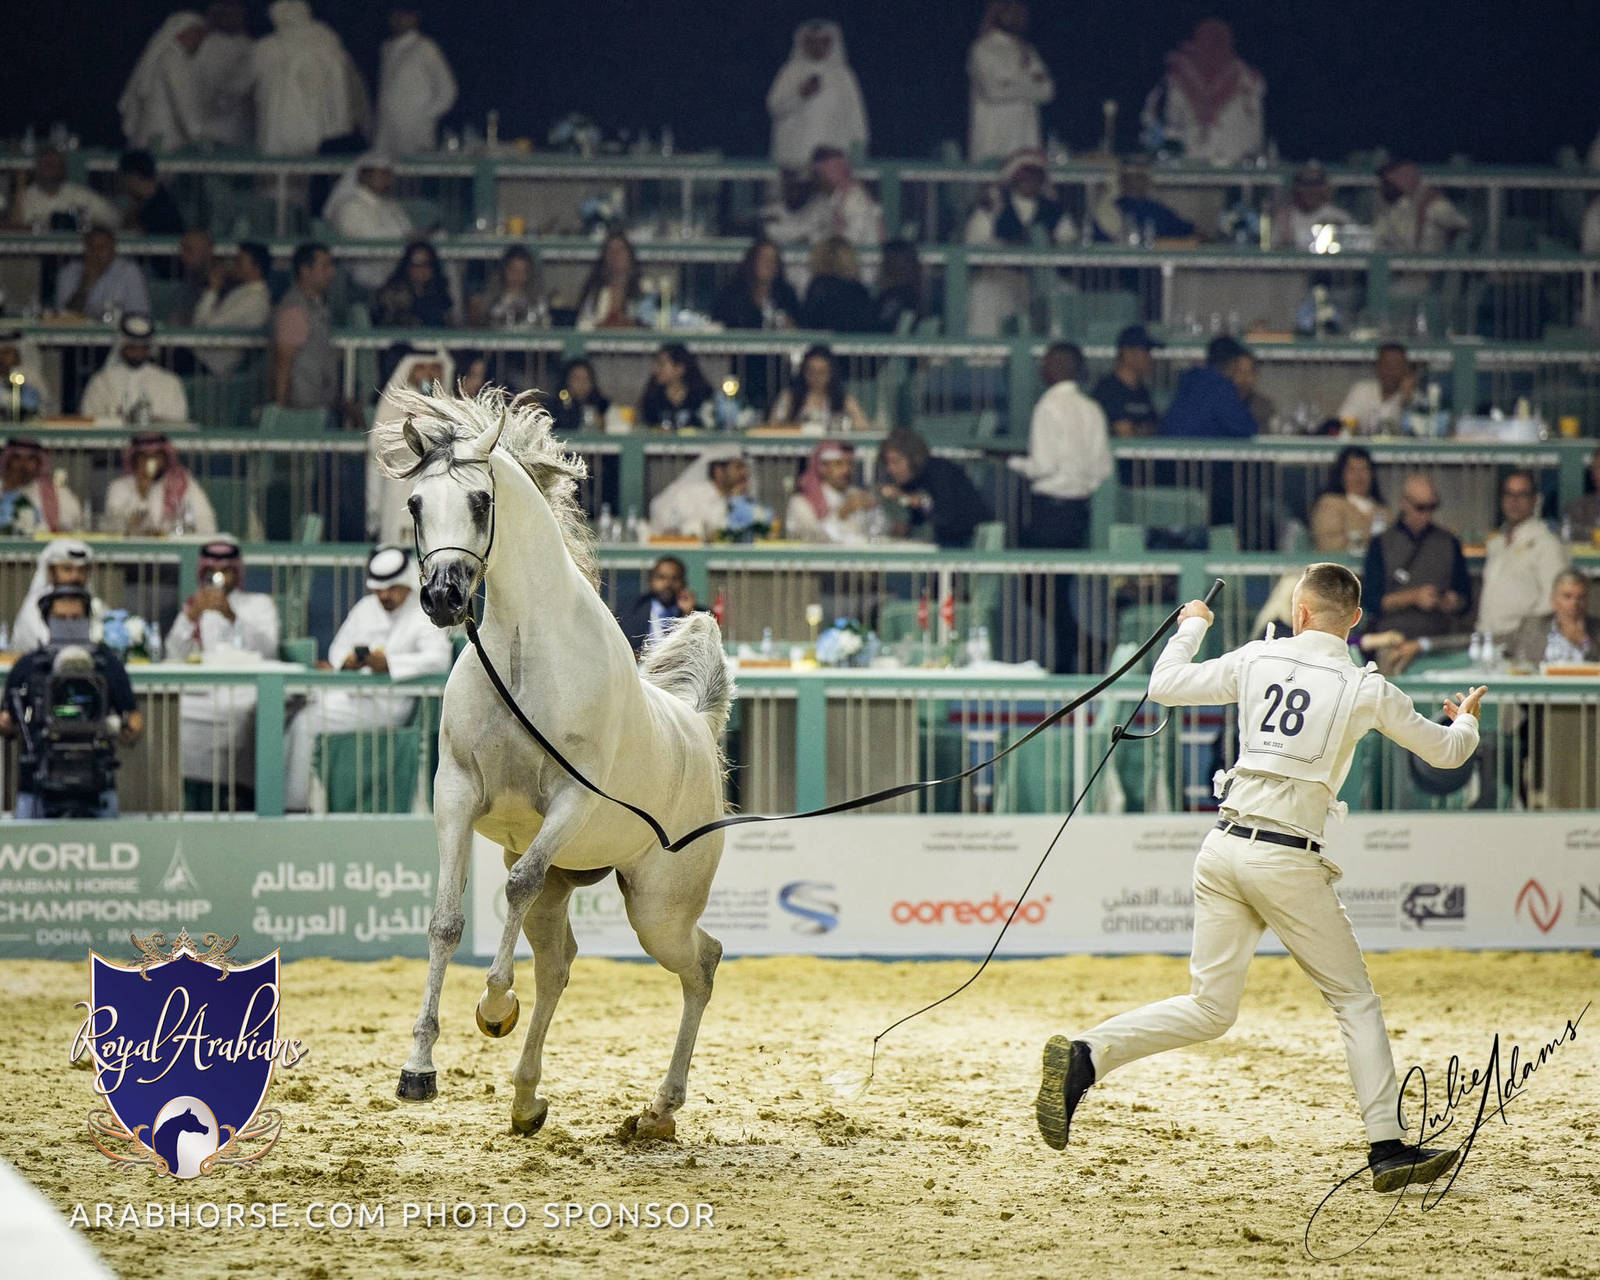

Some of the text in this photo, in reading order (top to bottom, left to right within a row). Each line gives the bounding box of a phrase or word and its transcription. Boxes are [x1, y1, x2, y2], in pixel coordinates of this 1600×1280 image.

[1260, 684, 1311, 737] 28
[0, 843, 140, 870] WORLD
[0, 878, 139, 893] RABIAN HORSE
[252, 862, 432, 898] بطولة العالم
[252, 906, 346, 942] العربية
[891, 892, 1047, 925] ooredoo
[36, 928, 93, 944] DOHA
